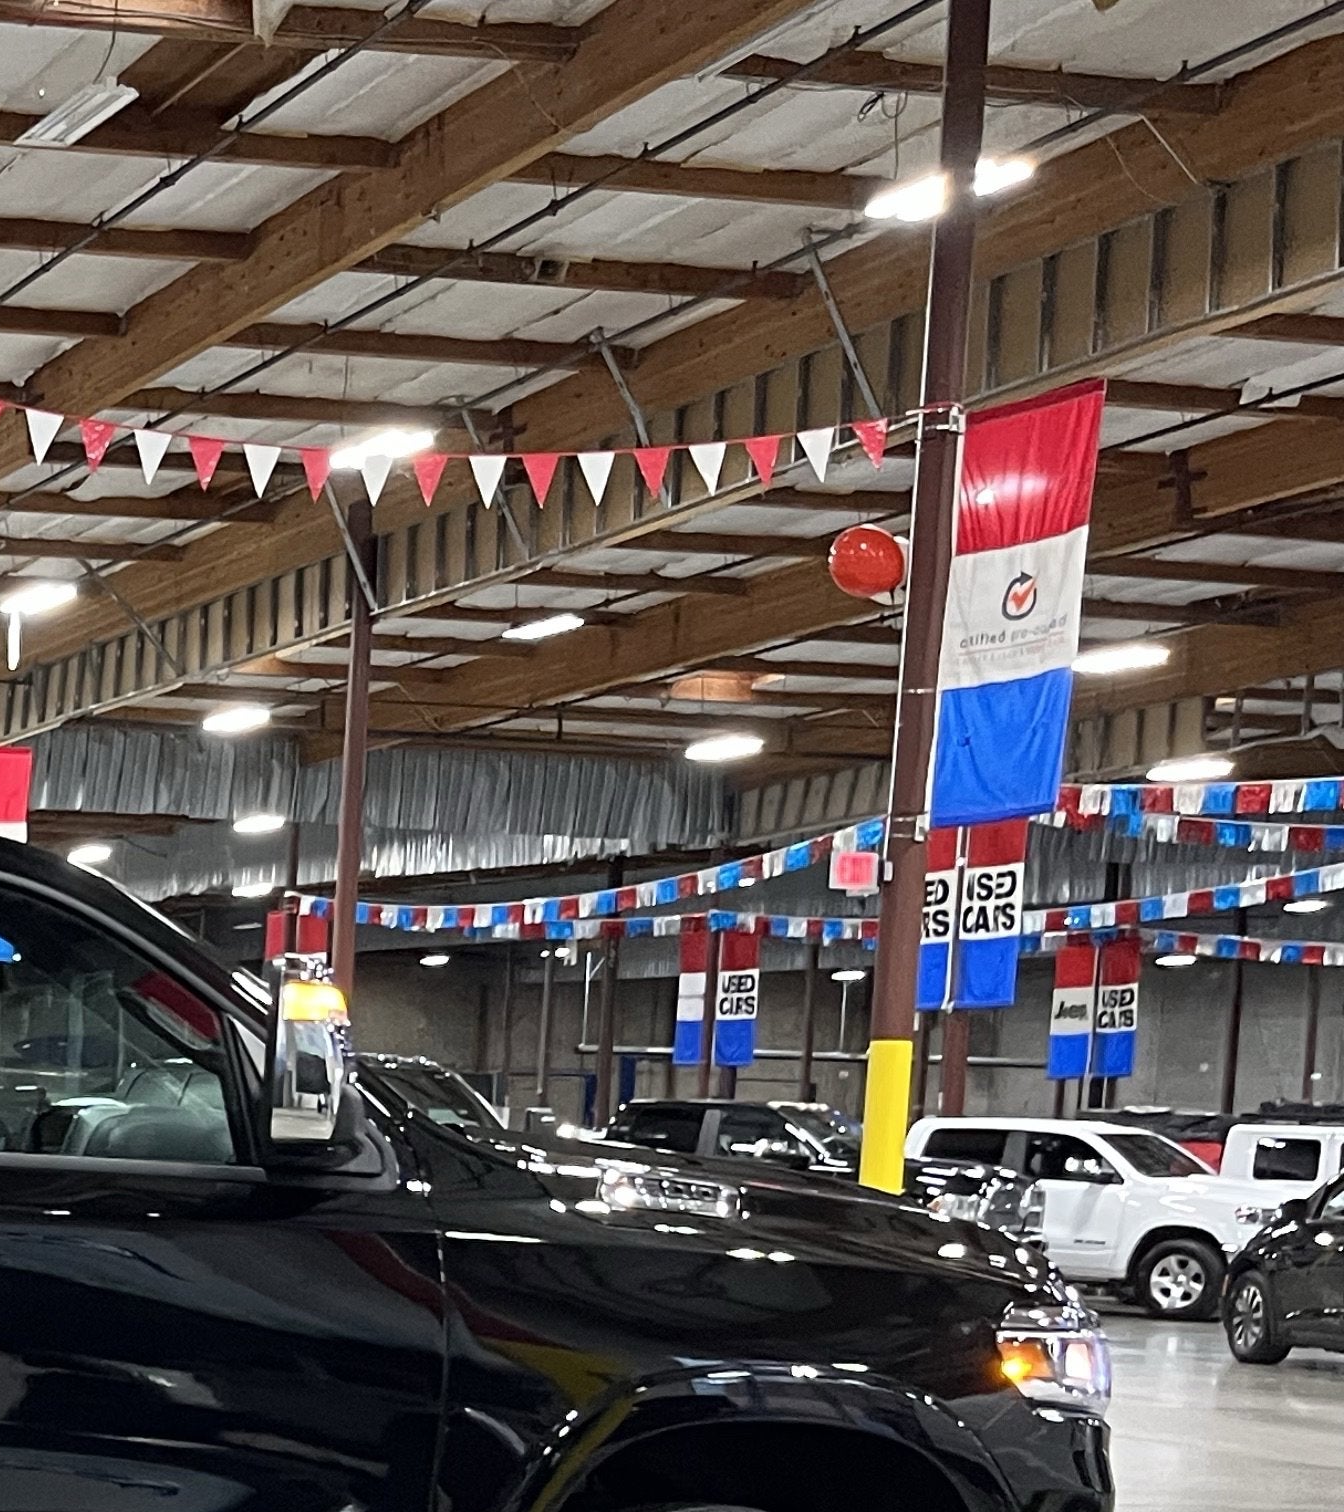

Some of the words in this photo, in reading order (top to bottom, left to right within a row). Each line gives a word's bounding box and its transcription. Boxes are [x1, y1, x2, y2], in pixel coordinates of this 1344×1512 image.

[924, 879, 950, 907] ED
[966, 870, 1017, 901] USED
[922, 909, 950, 938] RS
[721, 974, 755, 994] USED
